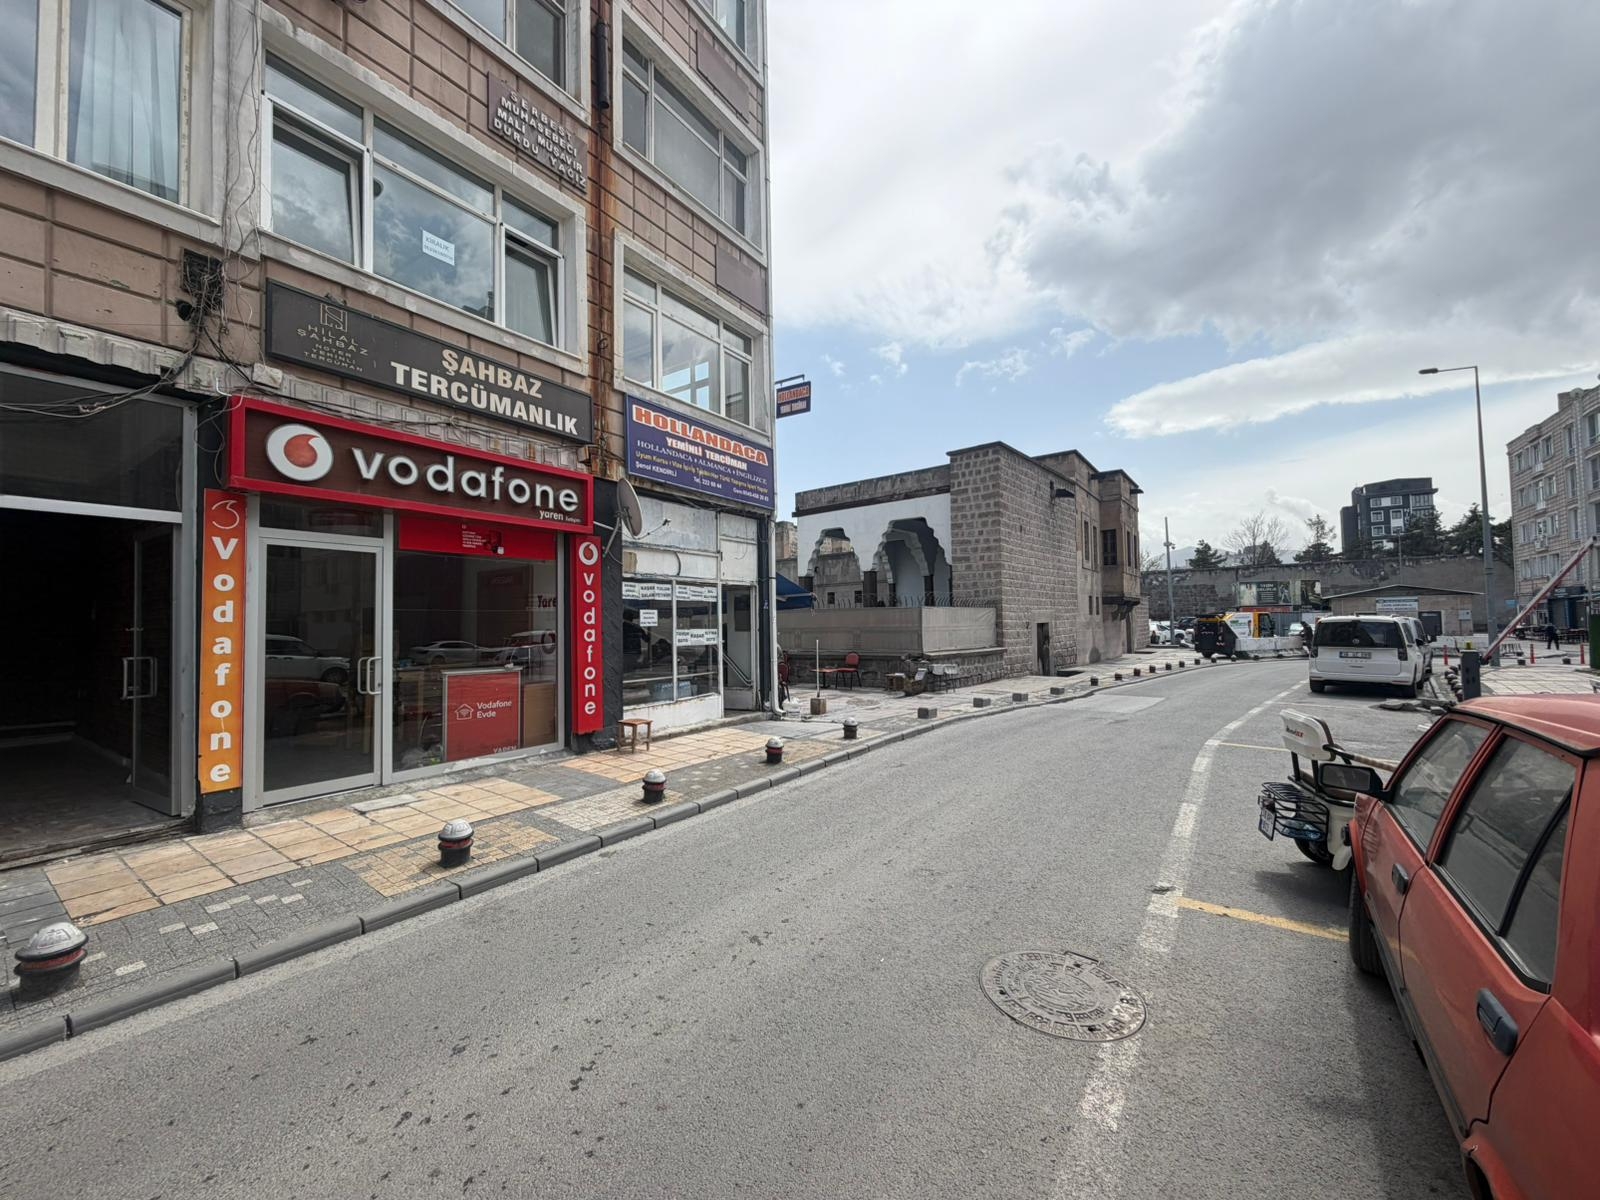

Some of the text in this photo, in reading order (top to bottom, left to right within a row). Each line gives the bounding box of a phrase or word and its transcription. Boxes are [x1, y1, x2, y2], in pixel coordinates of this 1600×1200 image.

[493, 117, 540, 155] DURDU
[510, 91, 573, 143] SERBEST
[390, 361, 578, 436] TERCÜMANLIK
[441, 349, 543, 399] ŞAHBAZ
[632, 404, 769, 467] HOLLANDACA
[637, 439, 693, 464] HOLLANDACA
[698, 458, 732, 475] ALMANCA
[665, 436, 703, 457] YEMİNLİ
[351, 447, 579, 512] vodafone
[539, 509, 564, 521] yaren
[210, 536, 239, 783] vodafone
[583, 572, 597, 715] vodafone
[476, 700, 513, 710] Vodafone
[476, 710, 497, 719] Evde
